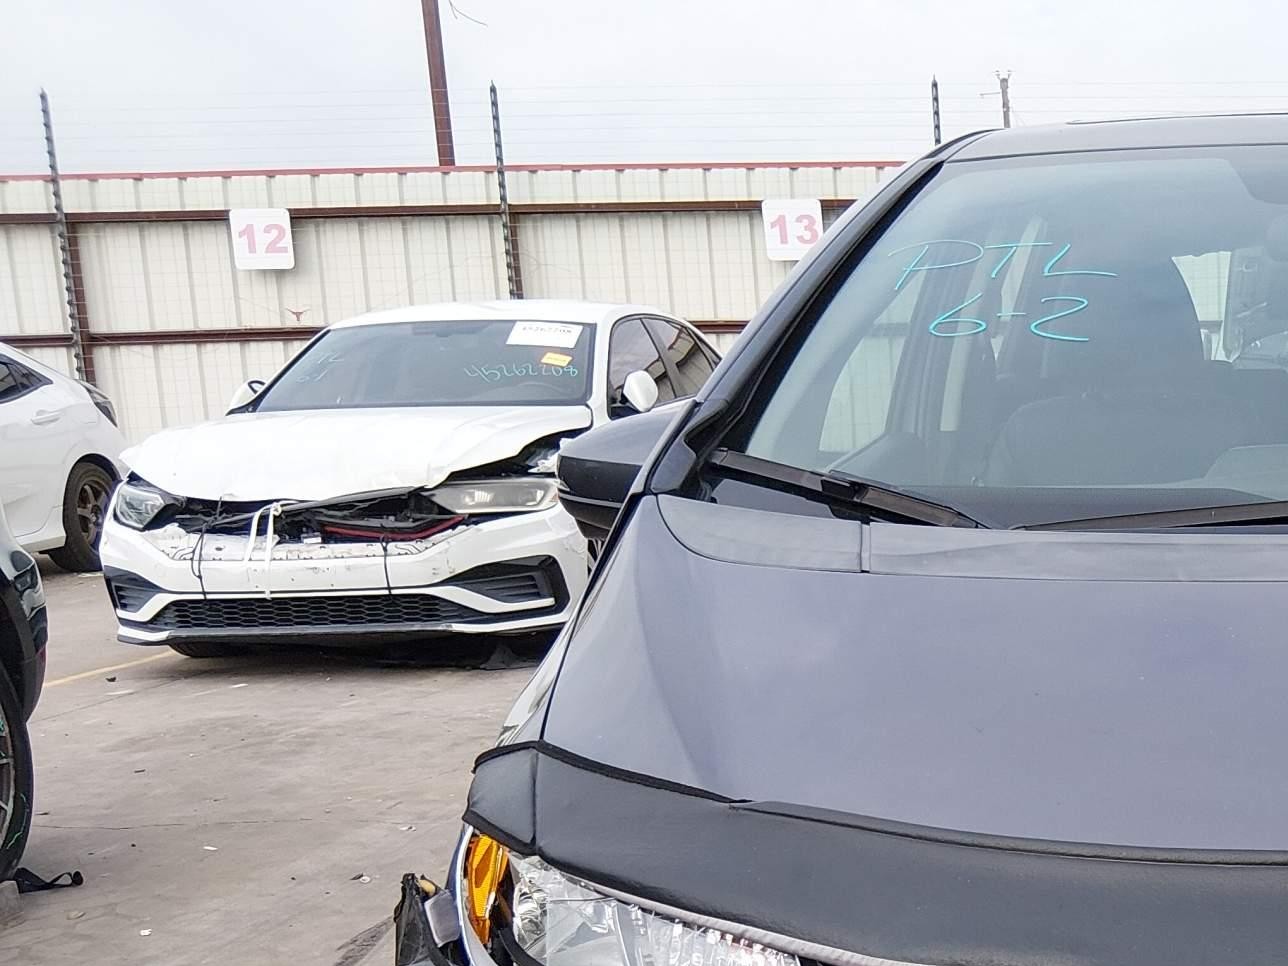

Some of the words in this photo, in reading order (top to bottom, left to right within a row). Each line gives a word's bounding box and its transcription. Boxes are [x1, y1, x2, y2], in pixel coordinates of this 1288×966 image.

[238, 223, 289, 254] 12
[769, 214, 819, 245] 13
[888, 239, 1118, 290] PTL
[928, 292, 1089, 341] 6-2
